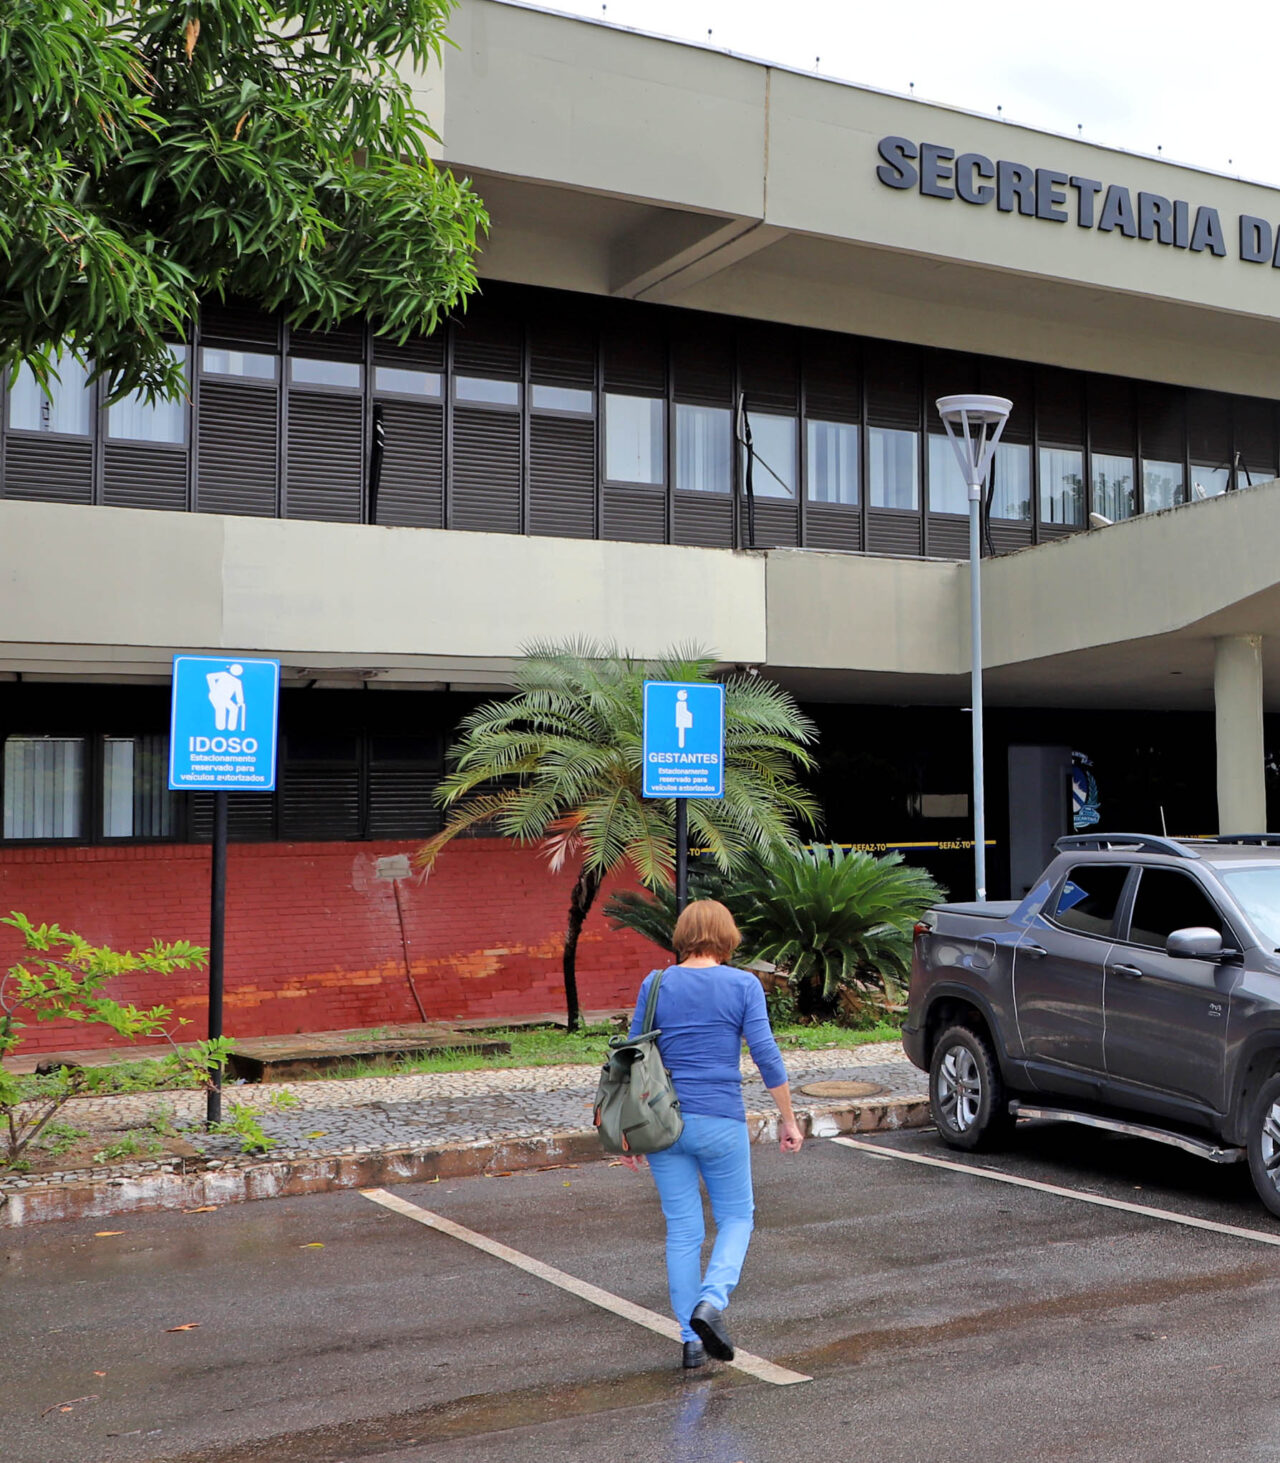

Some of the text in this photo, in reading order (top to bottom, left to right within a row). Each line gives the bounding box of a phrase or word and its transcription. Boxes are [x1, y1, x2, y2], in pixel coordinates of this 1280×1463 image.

[876, 136, 1227, 257] SECRETARIA
[189, 736, 258, 754] IDOSO
[190, 754, 256, 763] Estacionamento
[648, 752, 719, 764] GESTANTES
[191, 764, 255, 773] reservado para
[658, 767, 709, 775] Estacionamento
[180, 772, 265, 782] veículos autorizados
[693, 777, 708, 785] para
[679, 784, 716, 792] autorizados
[939, 840, 971, 850] SEFAZ-TO
